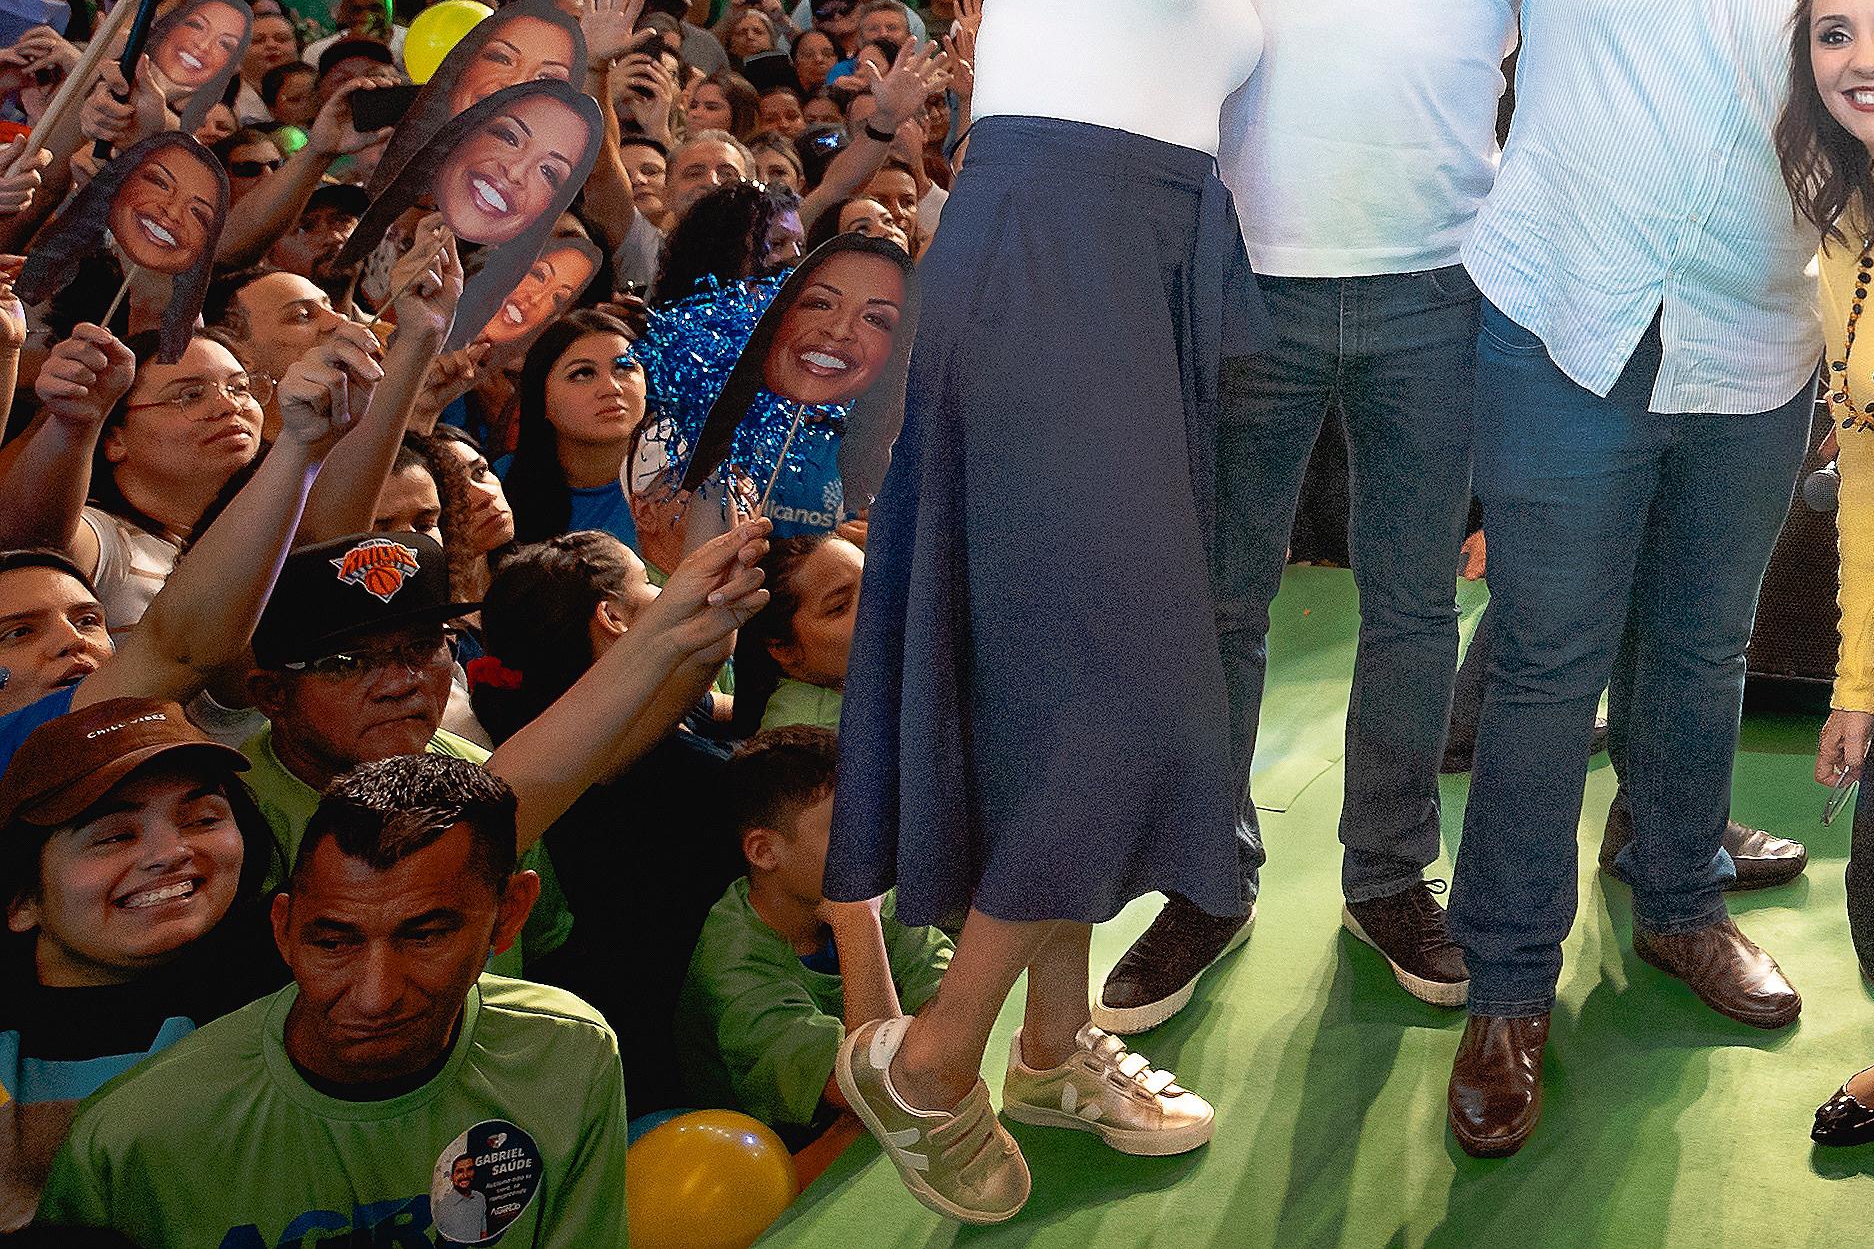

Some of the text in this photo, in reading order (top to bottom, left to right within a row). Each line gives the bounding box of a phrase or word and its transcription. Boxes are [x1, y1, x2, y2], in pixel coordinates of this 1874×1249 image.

[340, 546, 418, 579] KNICKS
[474, 1147, 526, 1167] GABRIEL
[491, 1157, 534, 1177] SAÚDE
